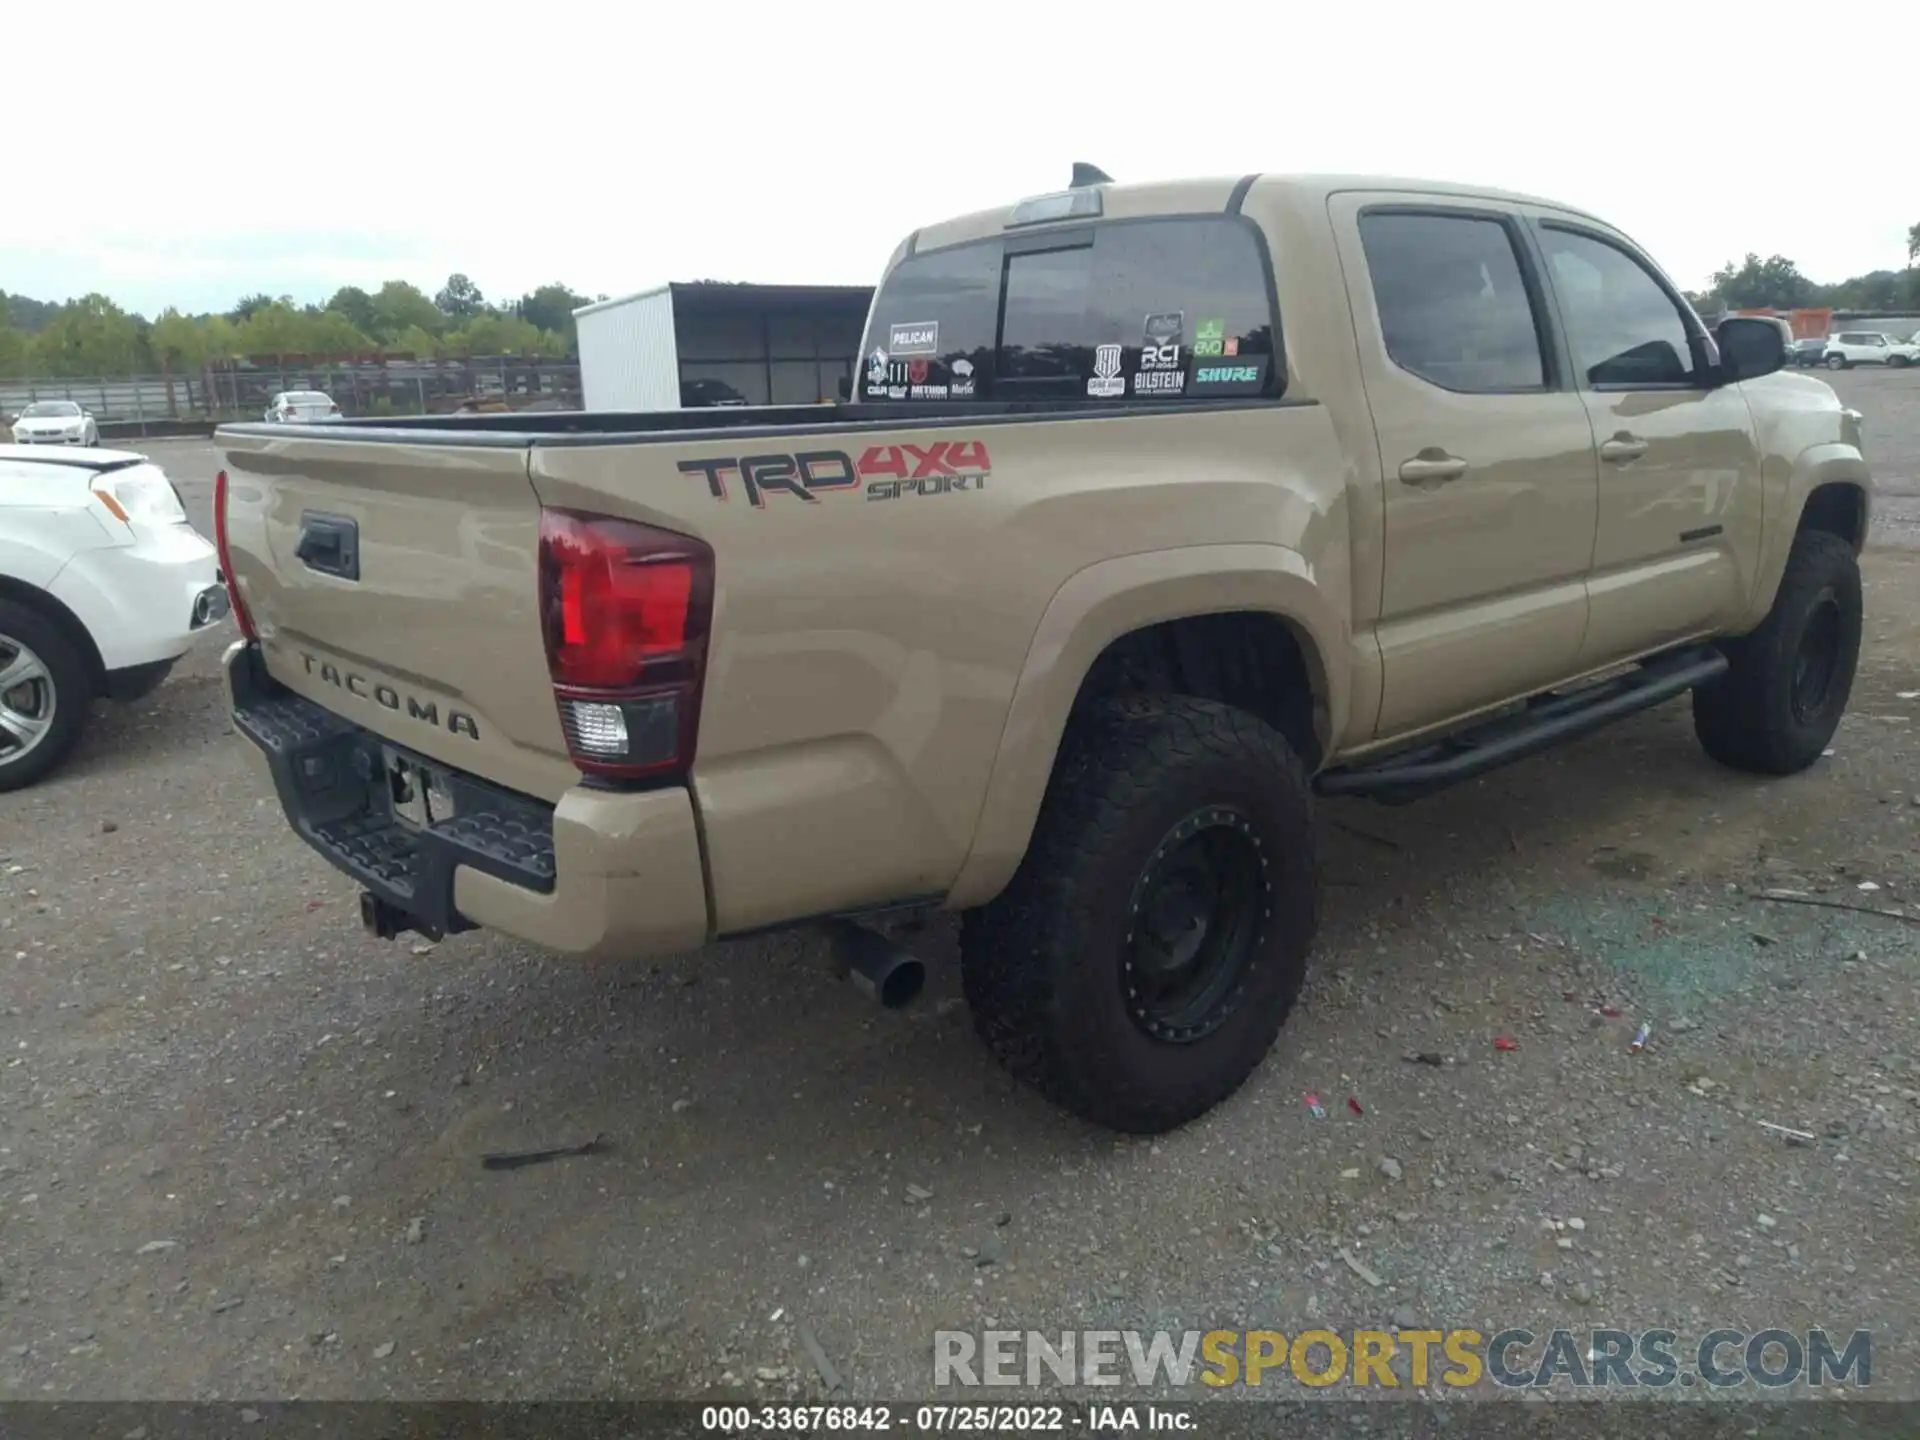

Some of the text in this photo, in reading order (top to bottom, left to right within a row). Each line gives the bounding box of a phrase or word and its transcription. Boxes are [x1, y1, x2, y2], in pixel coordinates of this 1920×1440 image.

[893, 330, 935, 345] PELICAN
[1141, 345, 1179, 363] RCI
[1135, 371, 1184, 389] BILSTEIN
[1196, 366, 1258, 383] SHURE
[677, 450, 862, 509] TRD
[866, 471, 990, 502] SPORT
[299, 652, 481, 741] TACOMA
